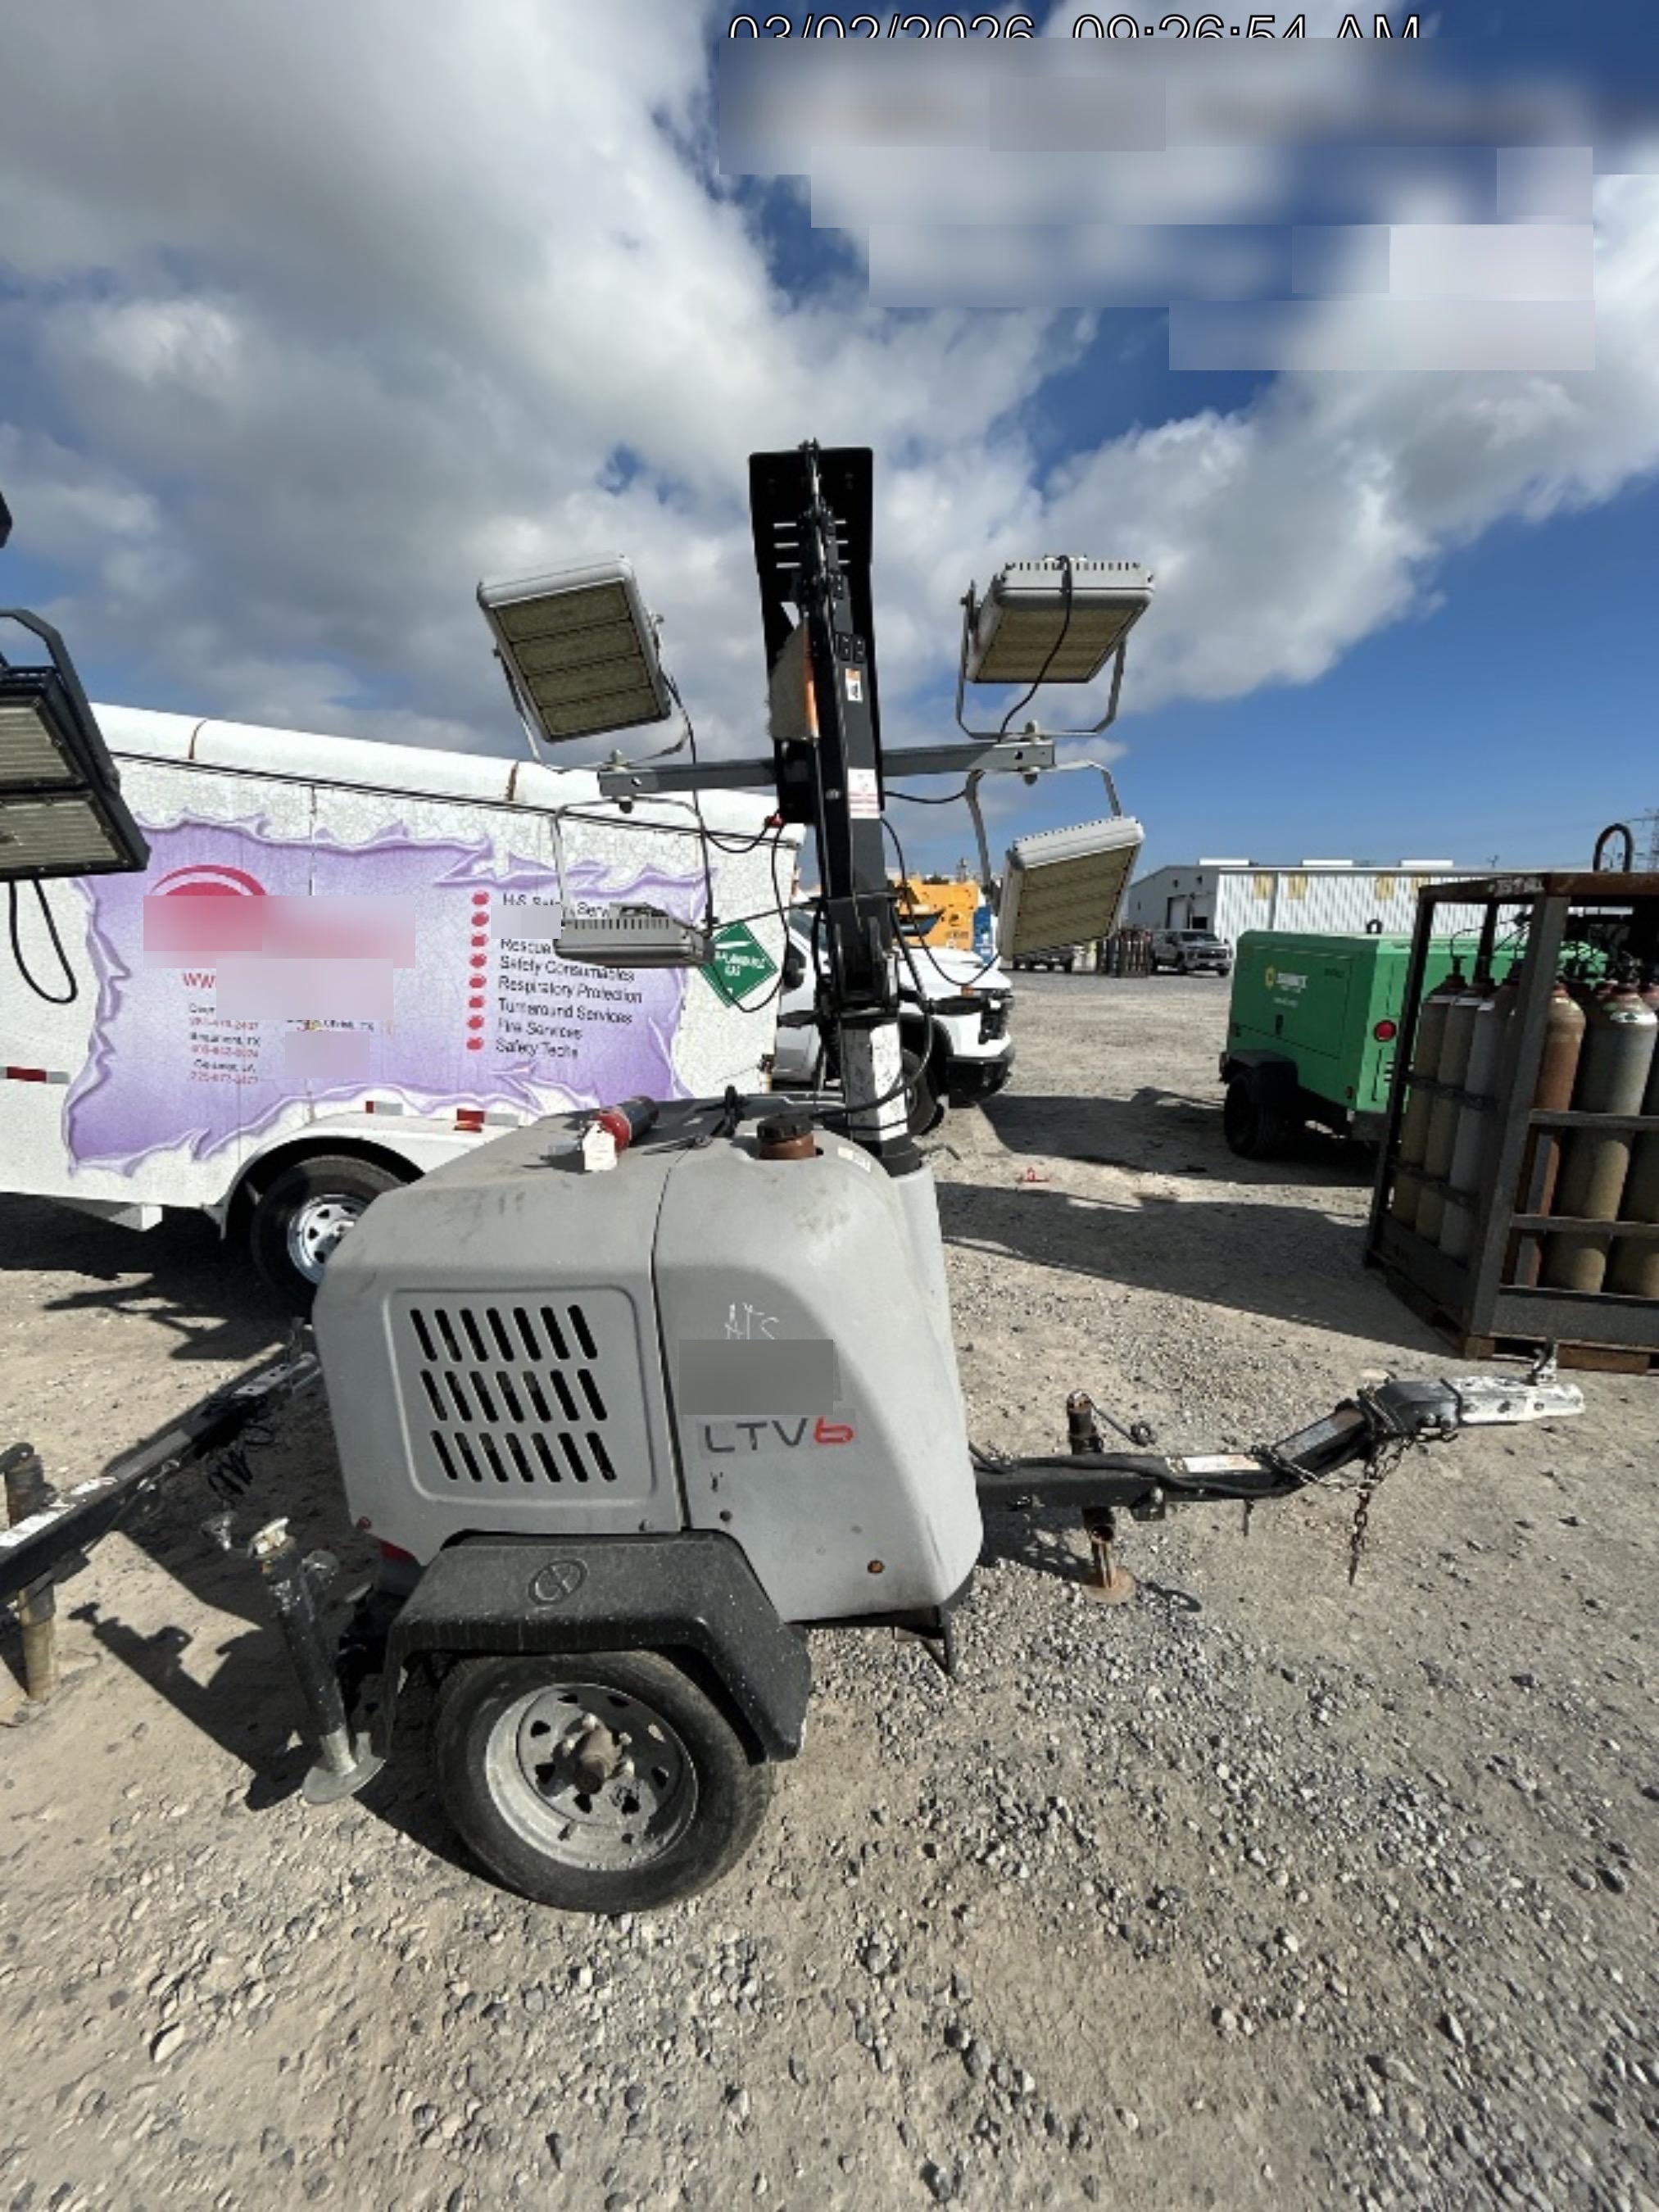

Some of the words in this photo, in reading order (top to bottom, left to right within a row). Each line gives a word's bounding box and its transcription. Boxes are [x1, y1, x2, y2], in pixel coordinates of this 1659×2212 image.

[501, 955, 541, 977] Safety
[498, 976, 573, 999] Respiratory
[577, 984, 643, 1004] Protection
[498, 997, 573, 1018] Turnaround
[577, 1005, 633, 1025] Services
